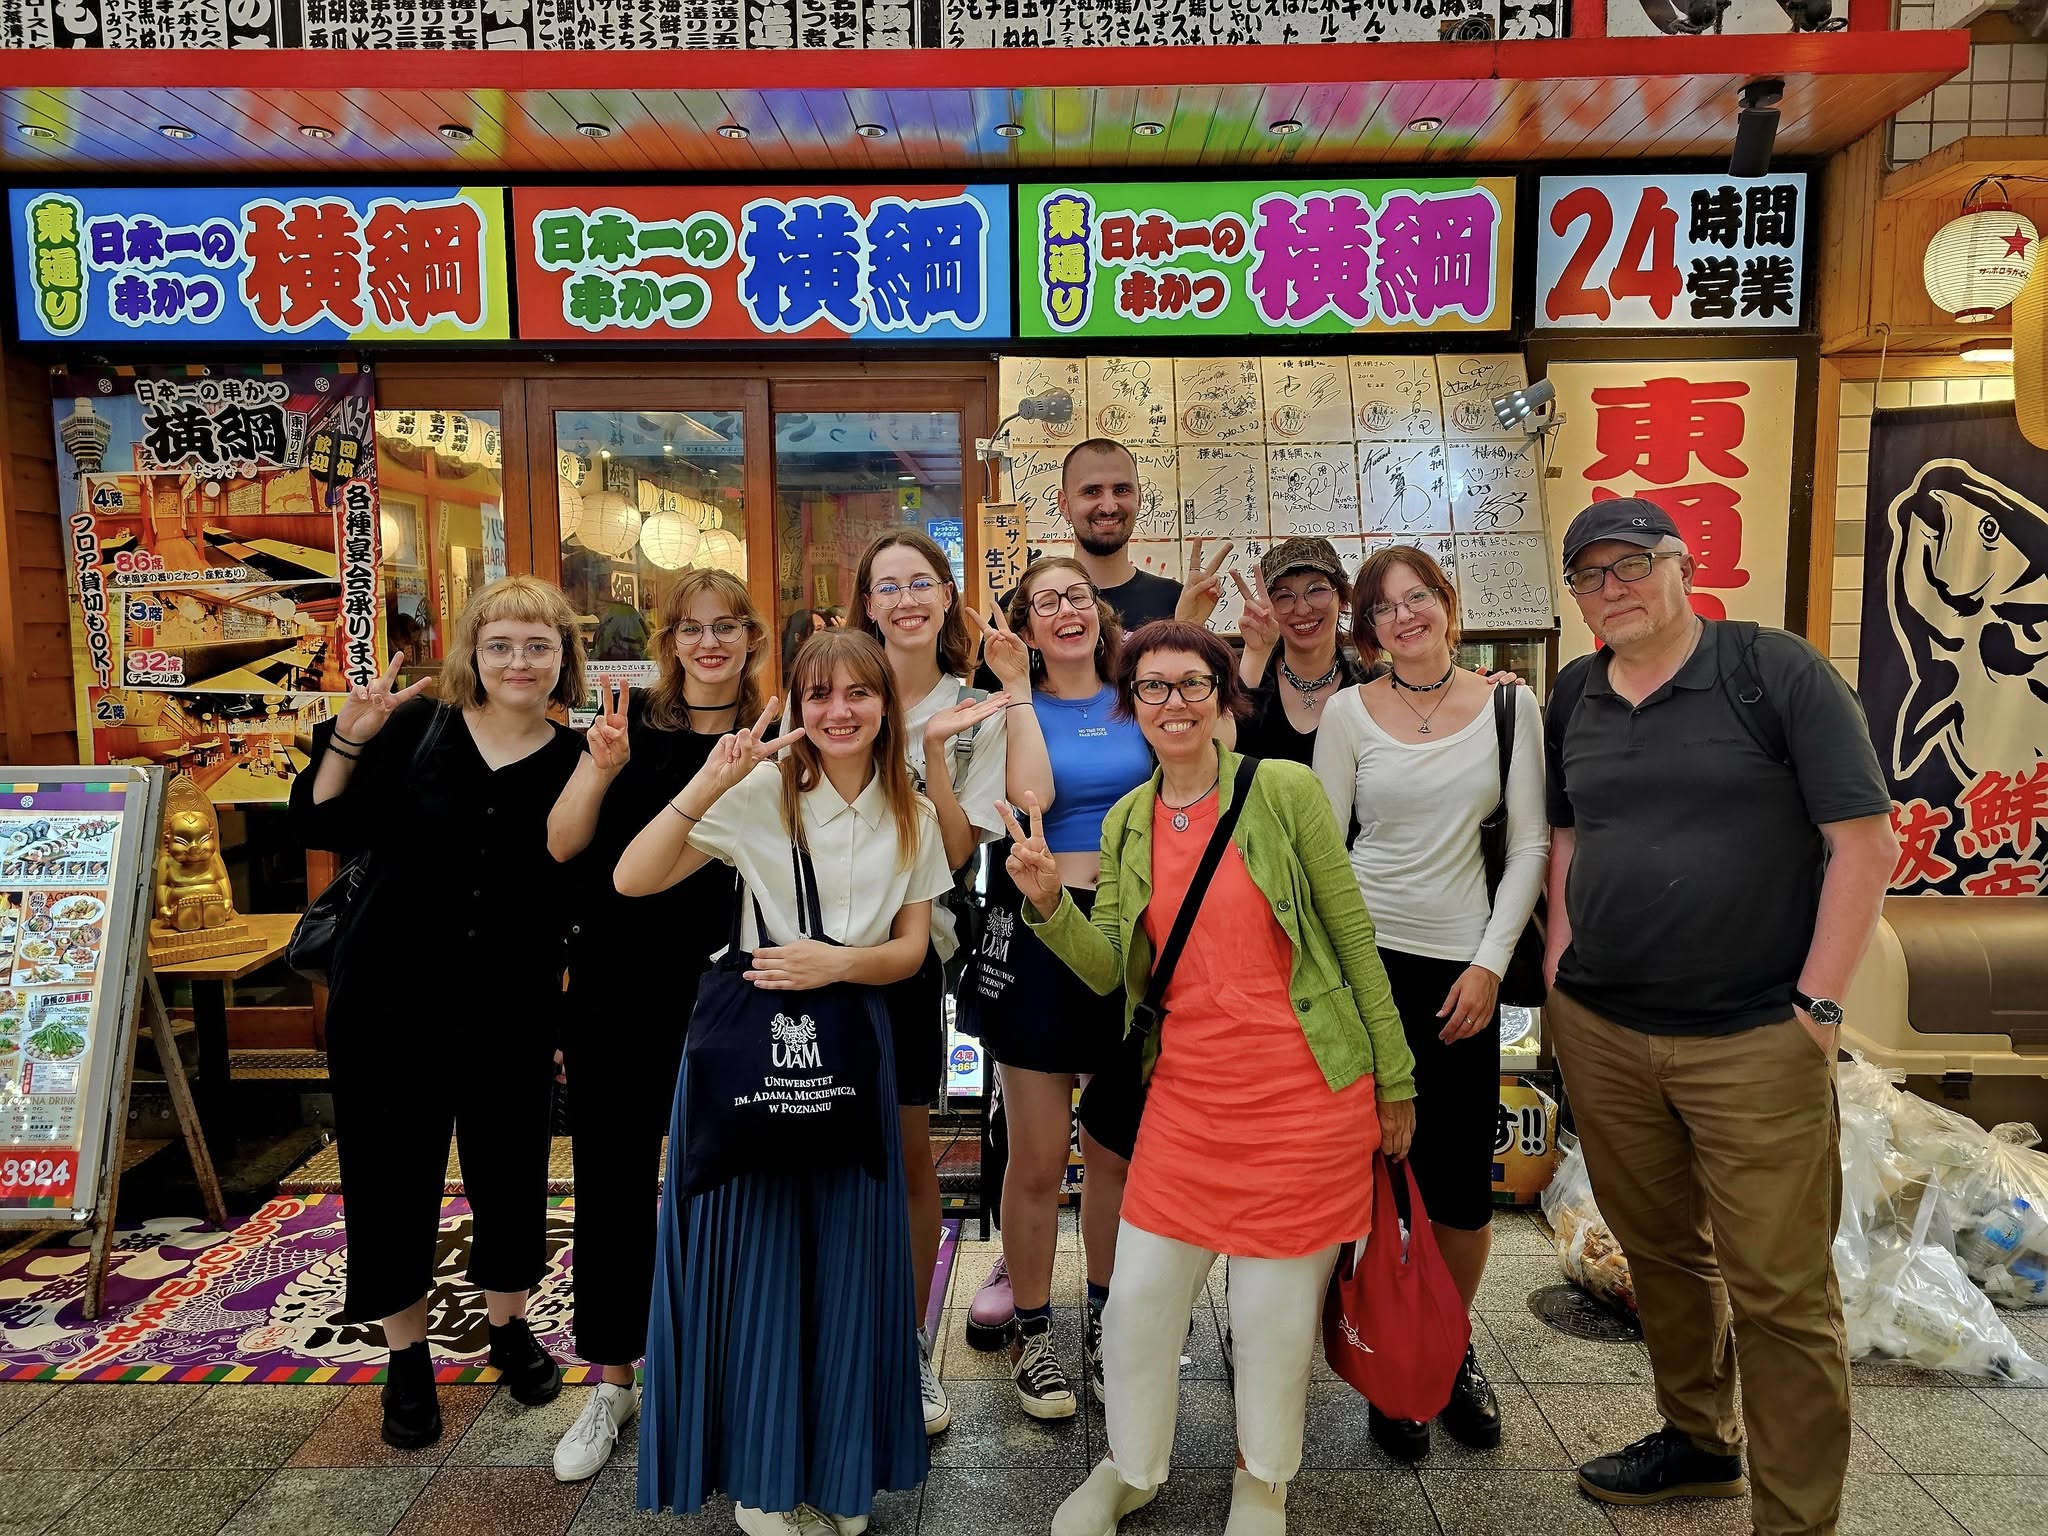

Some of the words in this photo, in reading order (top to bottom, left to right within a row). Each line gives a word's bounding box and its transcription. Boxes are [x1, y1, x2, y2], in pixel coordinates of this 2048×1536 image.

[90, 219, 236, 265] 日本一の
[539, 213, 729, 263] 日本一の
[1099, 214, 1247, 262] 日本一の
[1688, 184, 1799, 250] 時間
[33, 201, 79, 326] 東通り
[243, 201, 484, 327] 横綱
[743, 201, 984, 327] 横綱
[1046, 197, 1087, 323] 東通り
[1252, 193, 1496, 321] 横綱
[1545, 186, 1683, 321] 24
[114, 275, 220, 320] 串かつ
[569, 274, 705, 325] 串かつ
[1120, 269, 1226, 317] 串かつ
[1686, 255, 1796, 320] 営業
[143, 403, 288, 467] 横綱
[1581, 377, 1751, 621] 東通
[1632, 518, 1648, 527] CK
[1289, 521, 1355, 535] 2010.8.31
[1888, 803, 1952, 896] 抜
[771, 1042, 823, 1068] UAM
[753, 1090, 793, 1102] ADAMA
[794, 1086, 856, 1101] MICKIEWICZA
[781, 1101, 832, 1114] POZNANIU
